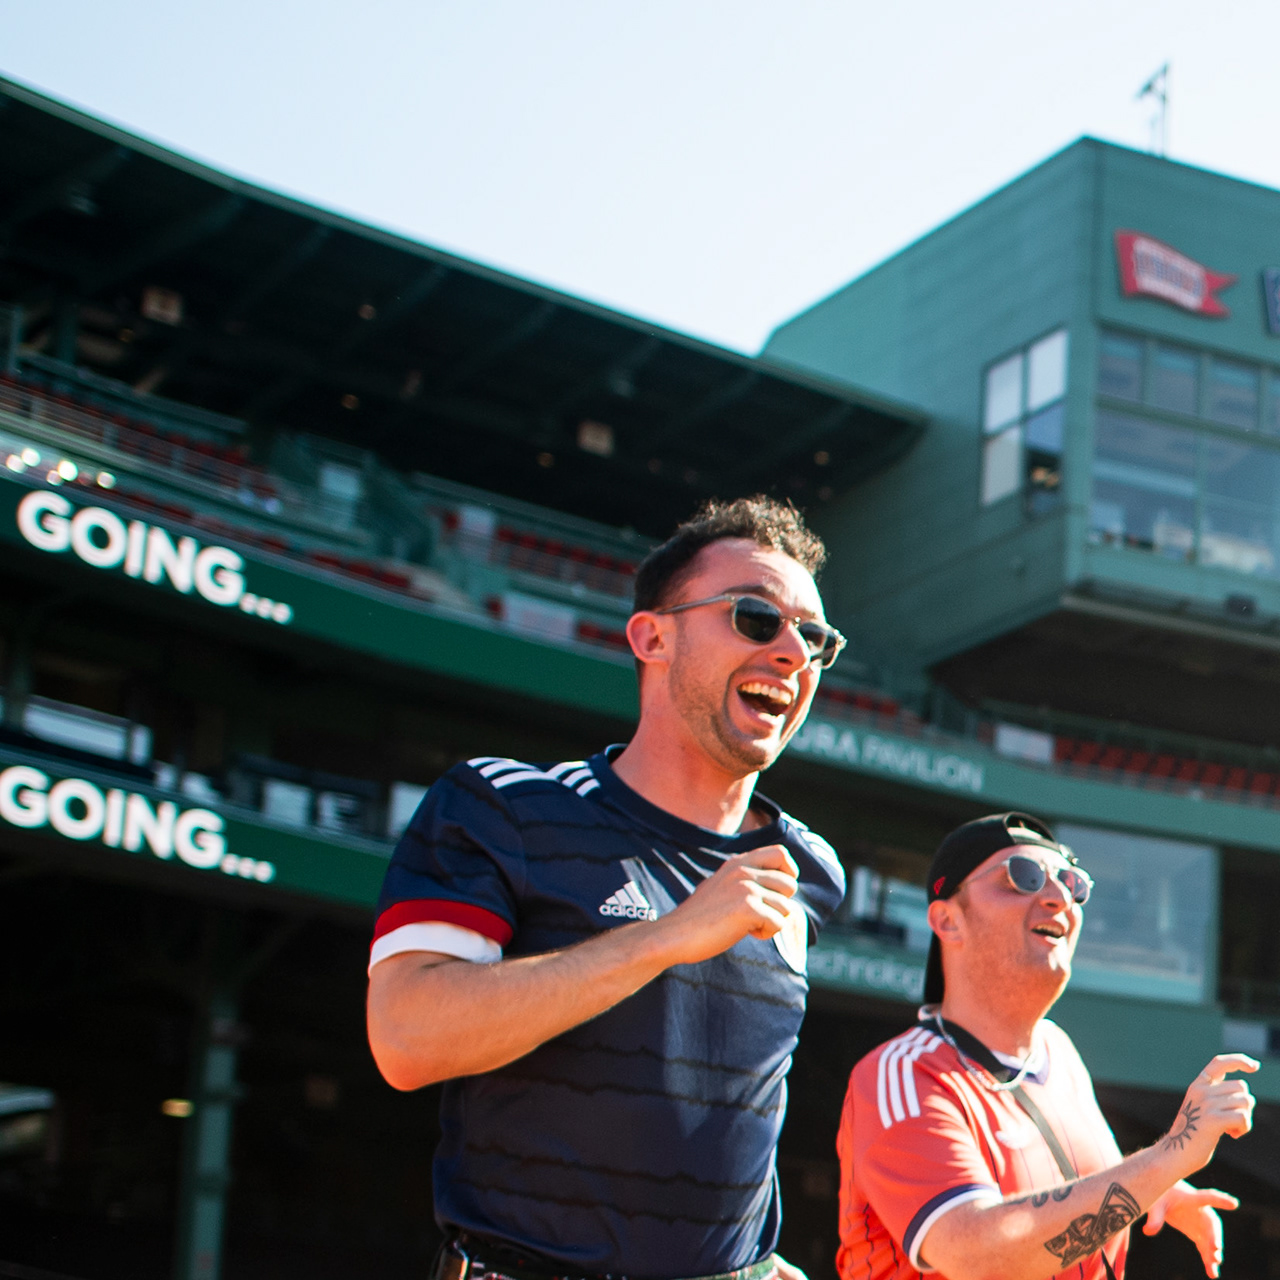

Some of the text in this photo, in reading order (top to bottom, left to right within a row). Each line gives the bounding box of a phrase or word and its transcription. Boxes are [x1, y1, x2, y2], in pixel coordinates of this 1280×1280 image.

[16, 489, 295, 626] GOING...
[861, 733, 984, 794] PAVILION
[0, 764, 277, 884] GOING...
[598, 903, 658, 922] adidas
